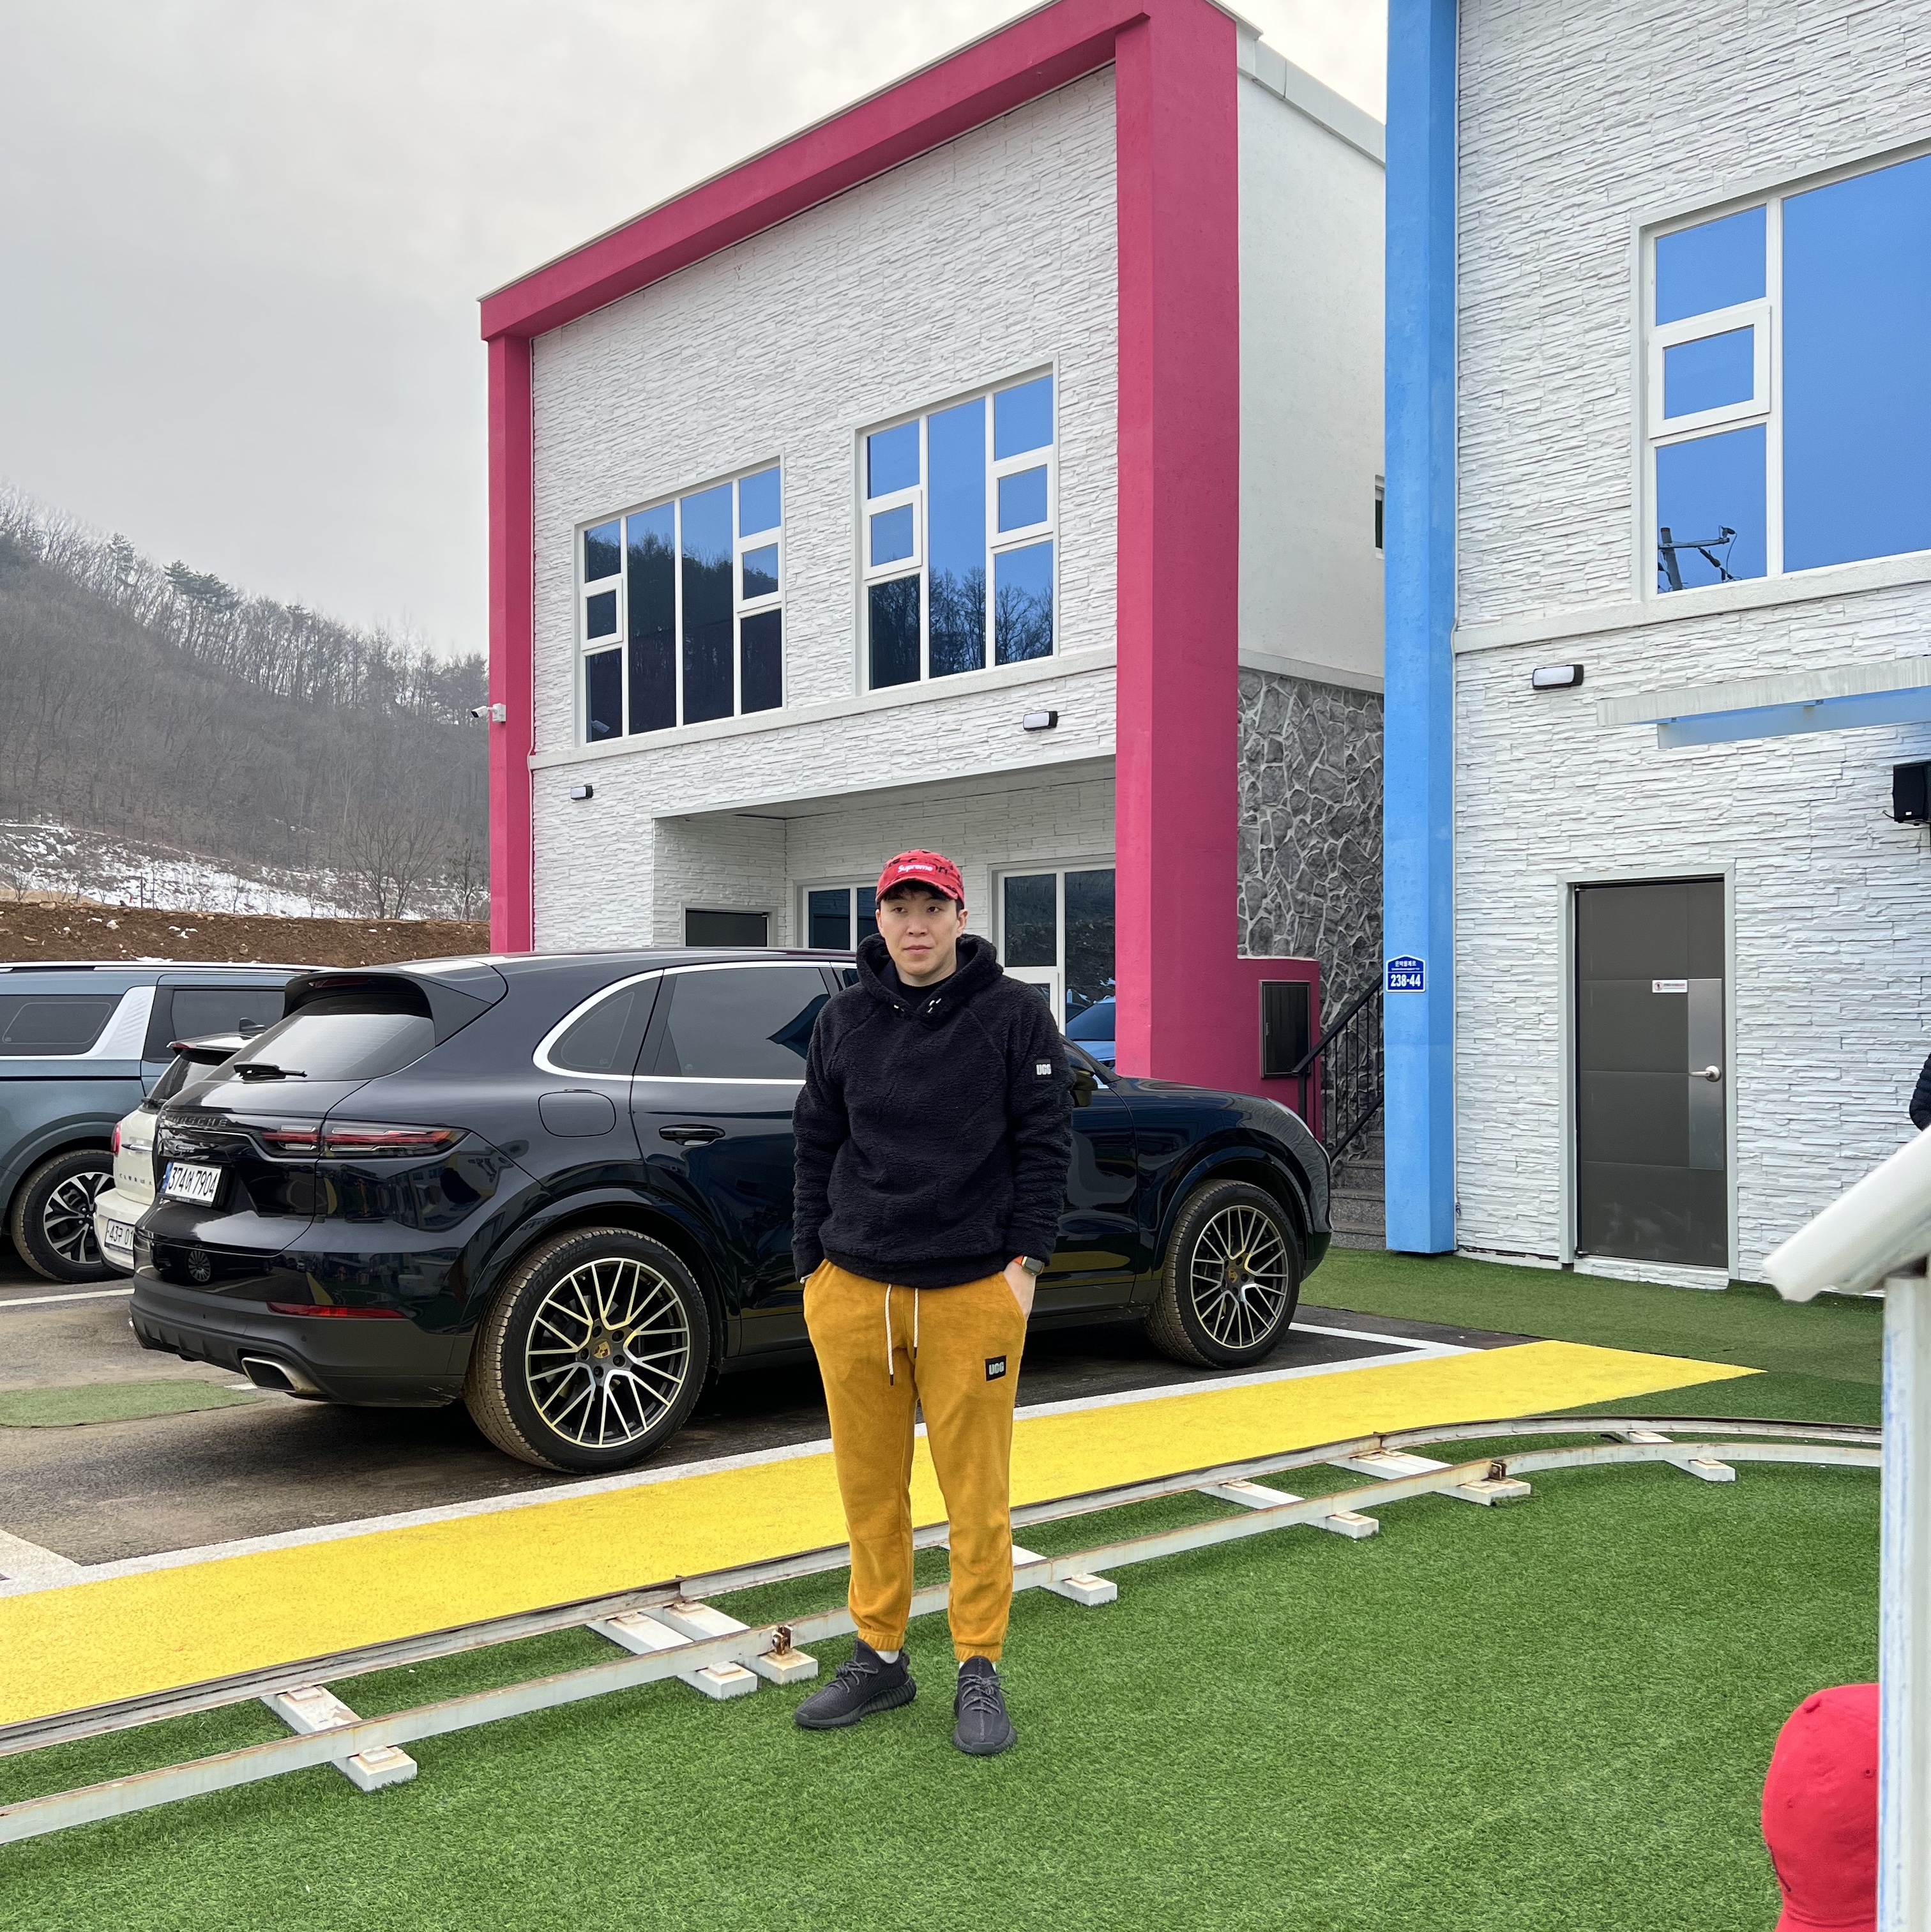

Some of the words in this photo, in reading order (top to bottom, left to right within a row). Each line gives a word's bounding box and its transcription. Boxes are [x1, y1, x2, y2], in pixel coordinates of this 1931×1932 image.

[897, 864, 934, 874] Supreme
[1390, 974, 1421, 987] 238-44
[1036, 1063, 1052, 1076] UGG
[988, 1361, 1004, 1376] UGG
